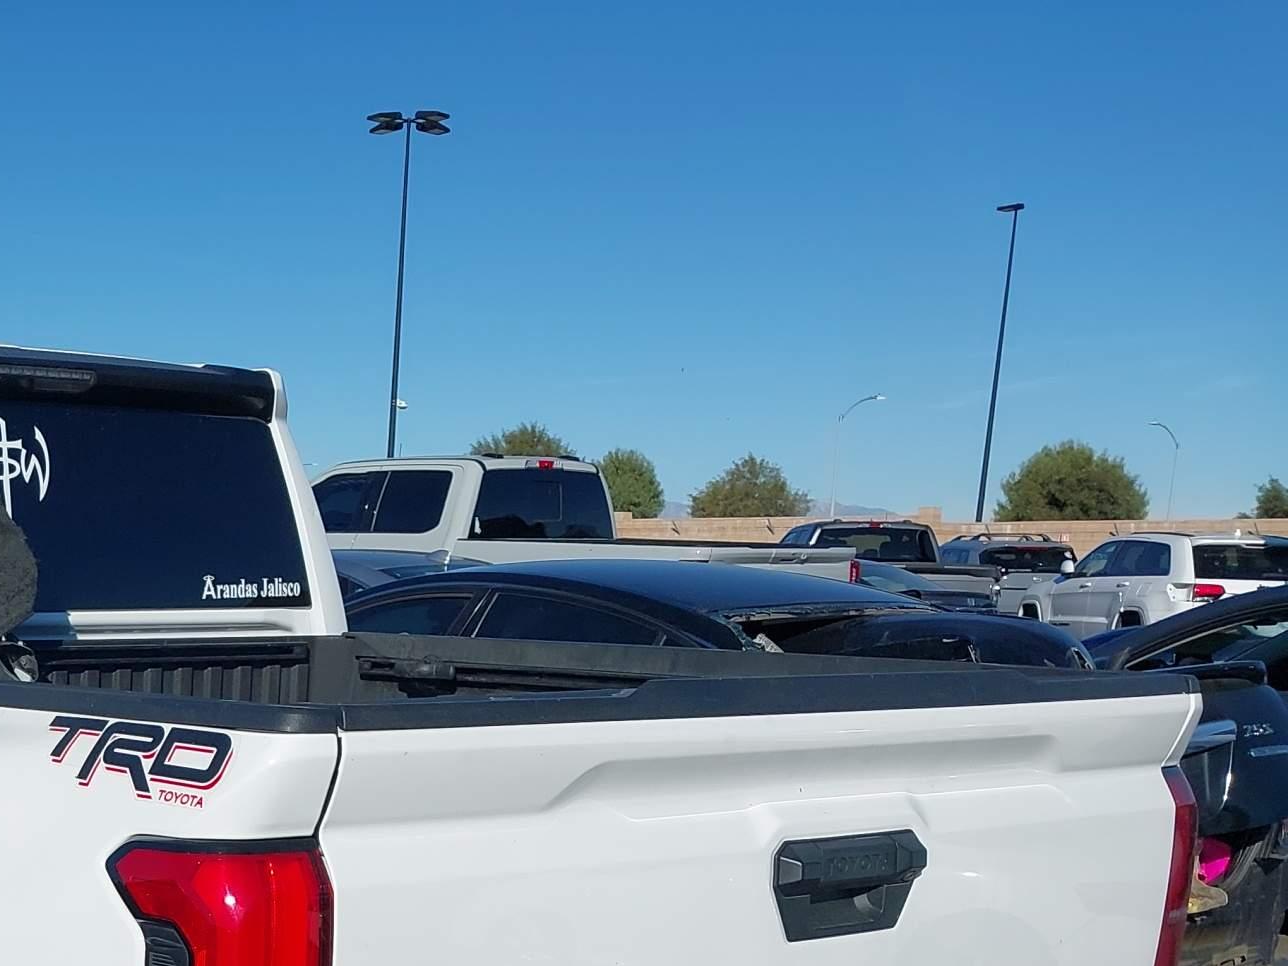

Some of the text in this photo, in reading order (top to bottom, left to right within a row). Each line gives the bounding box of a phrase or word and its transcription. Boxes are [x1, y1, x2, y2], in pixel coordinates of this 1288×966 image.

[201, 575, 301, 600] Arandas Jalisco
[49, 716, 234, 799] TRD
[158, 789, 203, 809] TOYOTA
